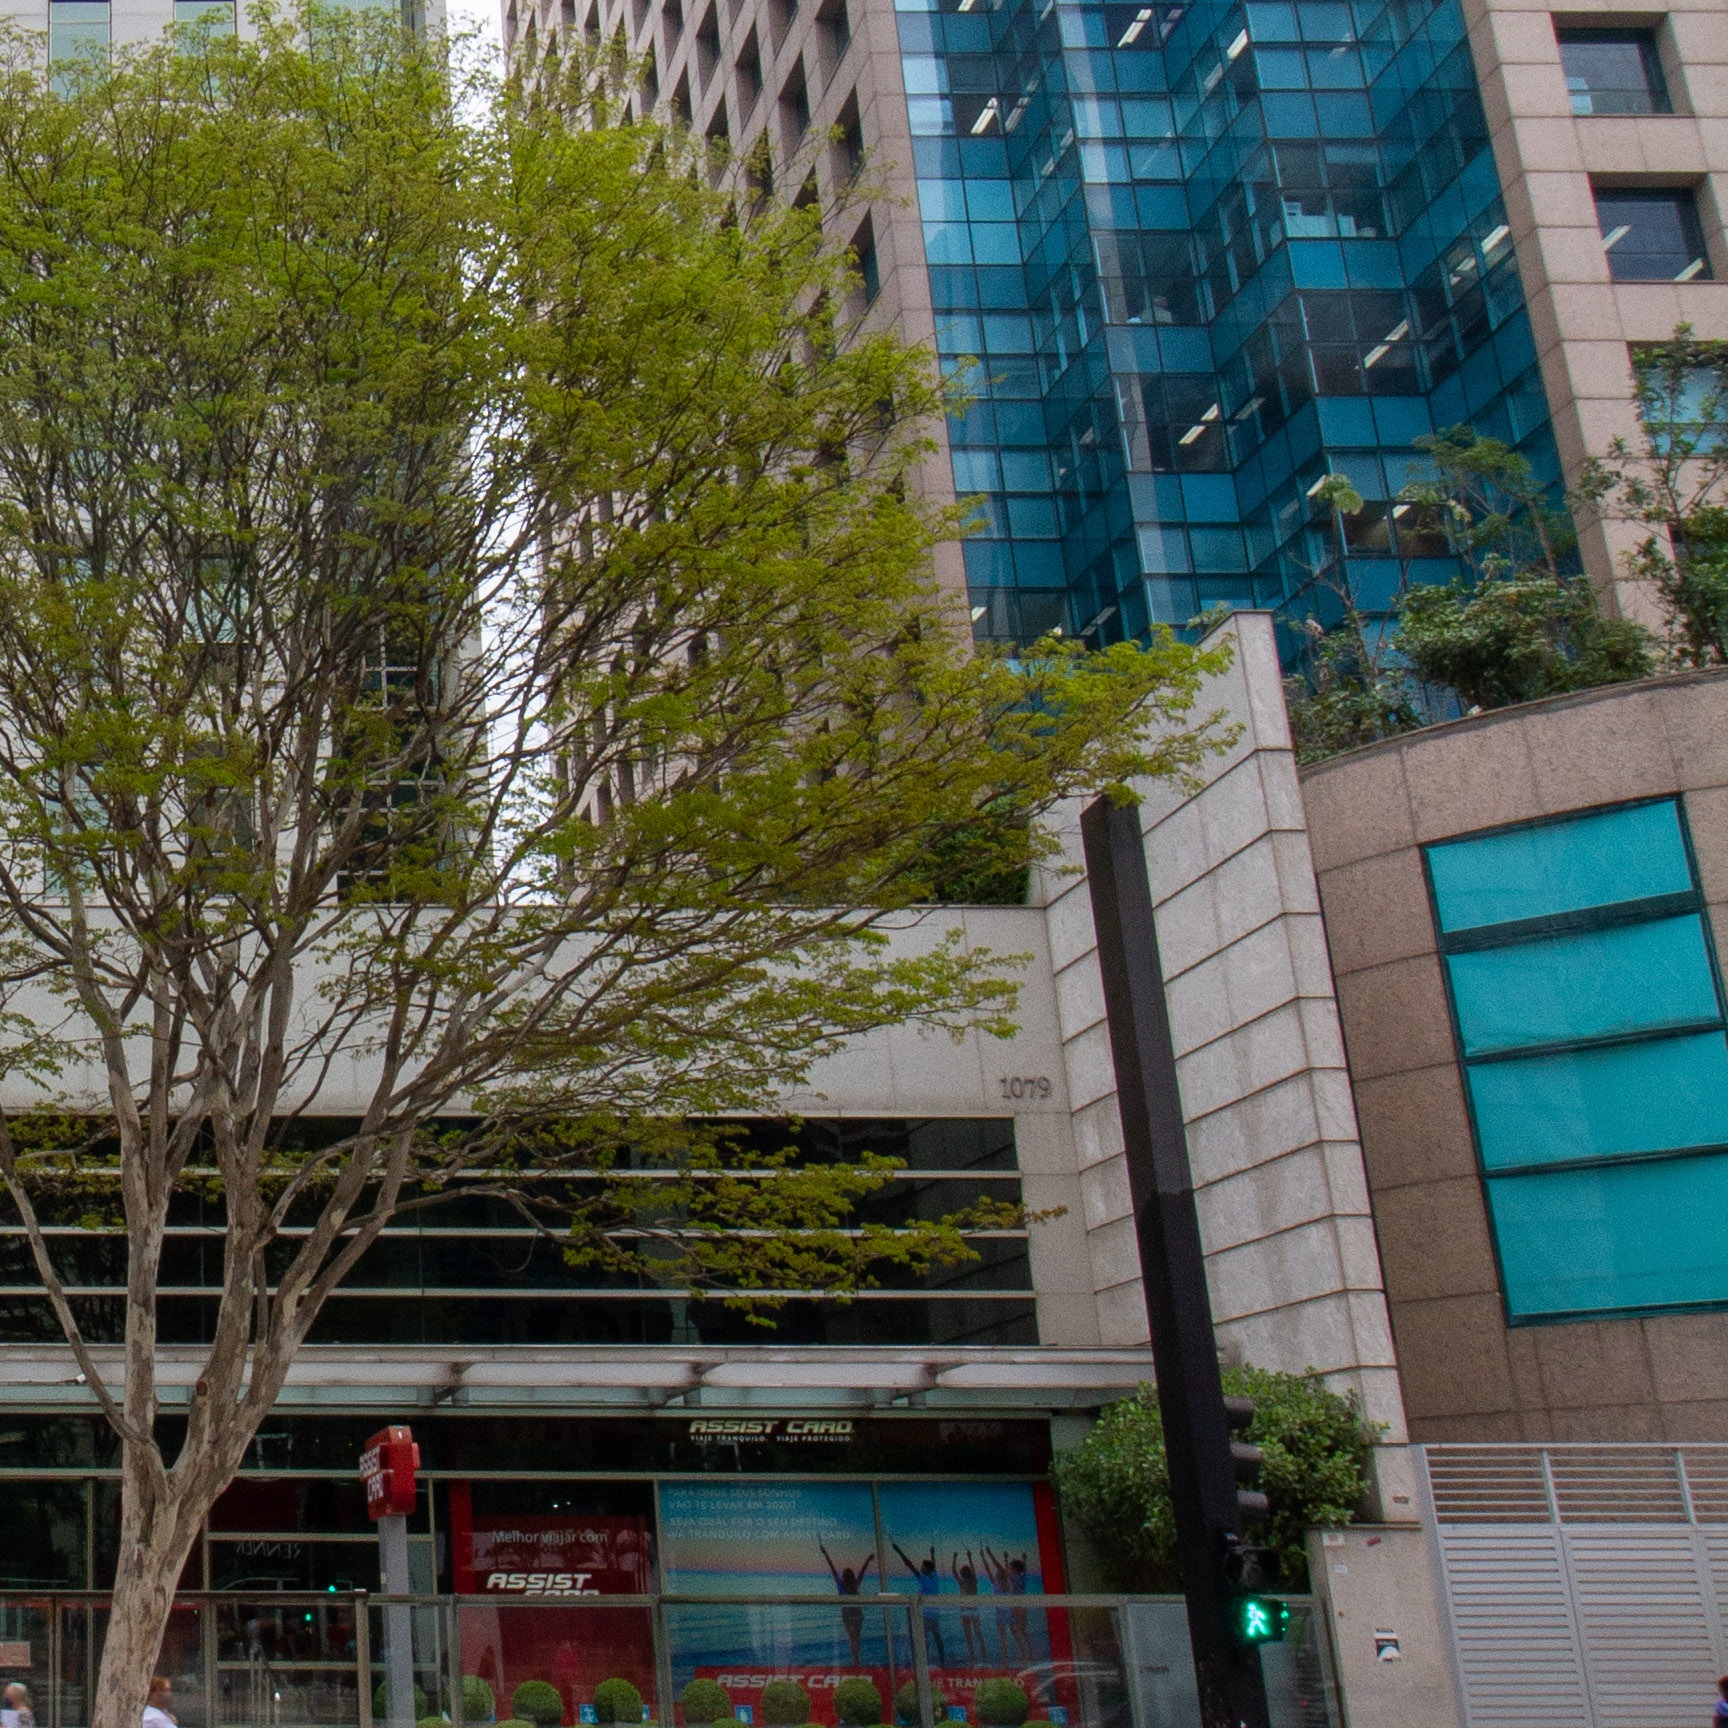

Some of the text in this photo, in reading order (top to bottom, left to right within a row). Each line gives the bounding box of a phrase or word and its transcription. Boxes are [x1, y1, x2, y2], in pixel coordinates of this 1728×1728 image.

[1000, 1075, 1052, 1100] 1079
[689, 1420, 853, 1433] ASSIST CARD
[492, 1530, 539, 1543] Melhor
[579, 1532, 608, 1543] com
[486, 1573, 593, 1589] ASSIST
